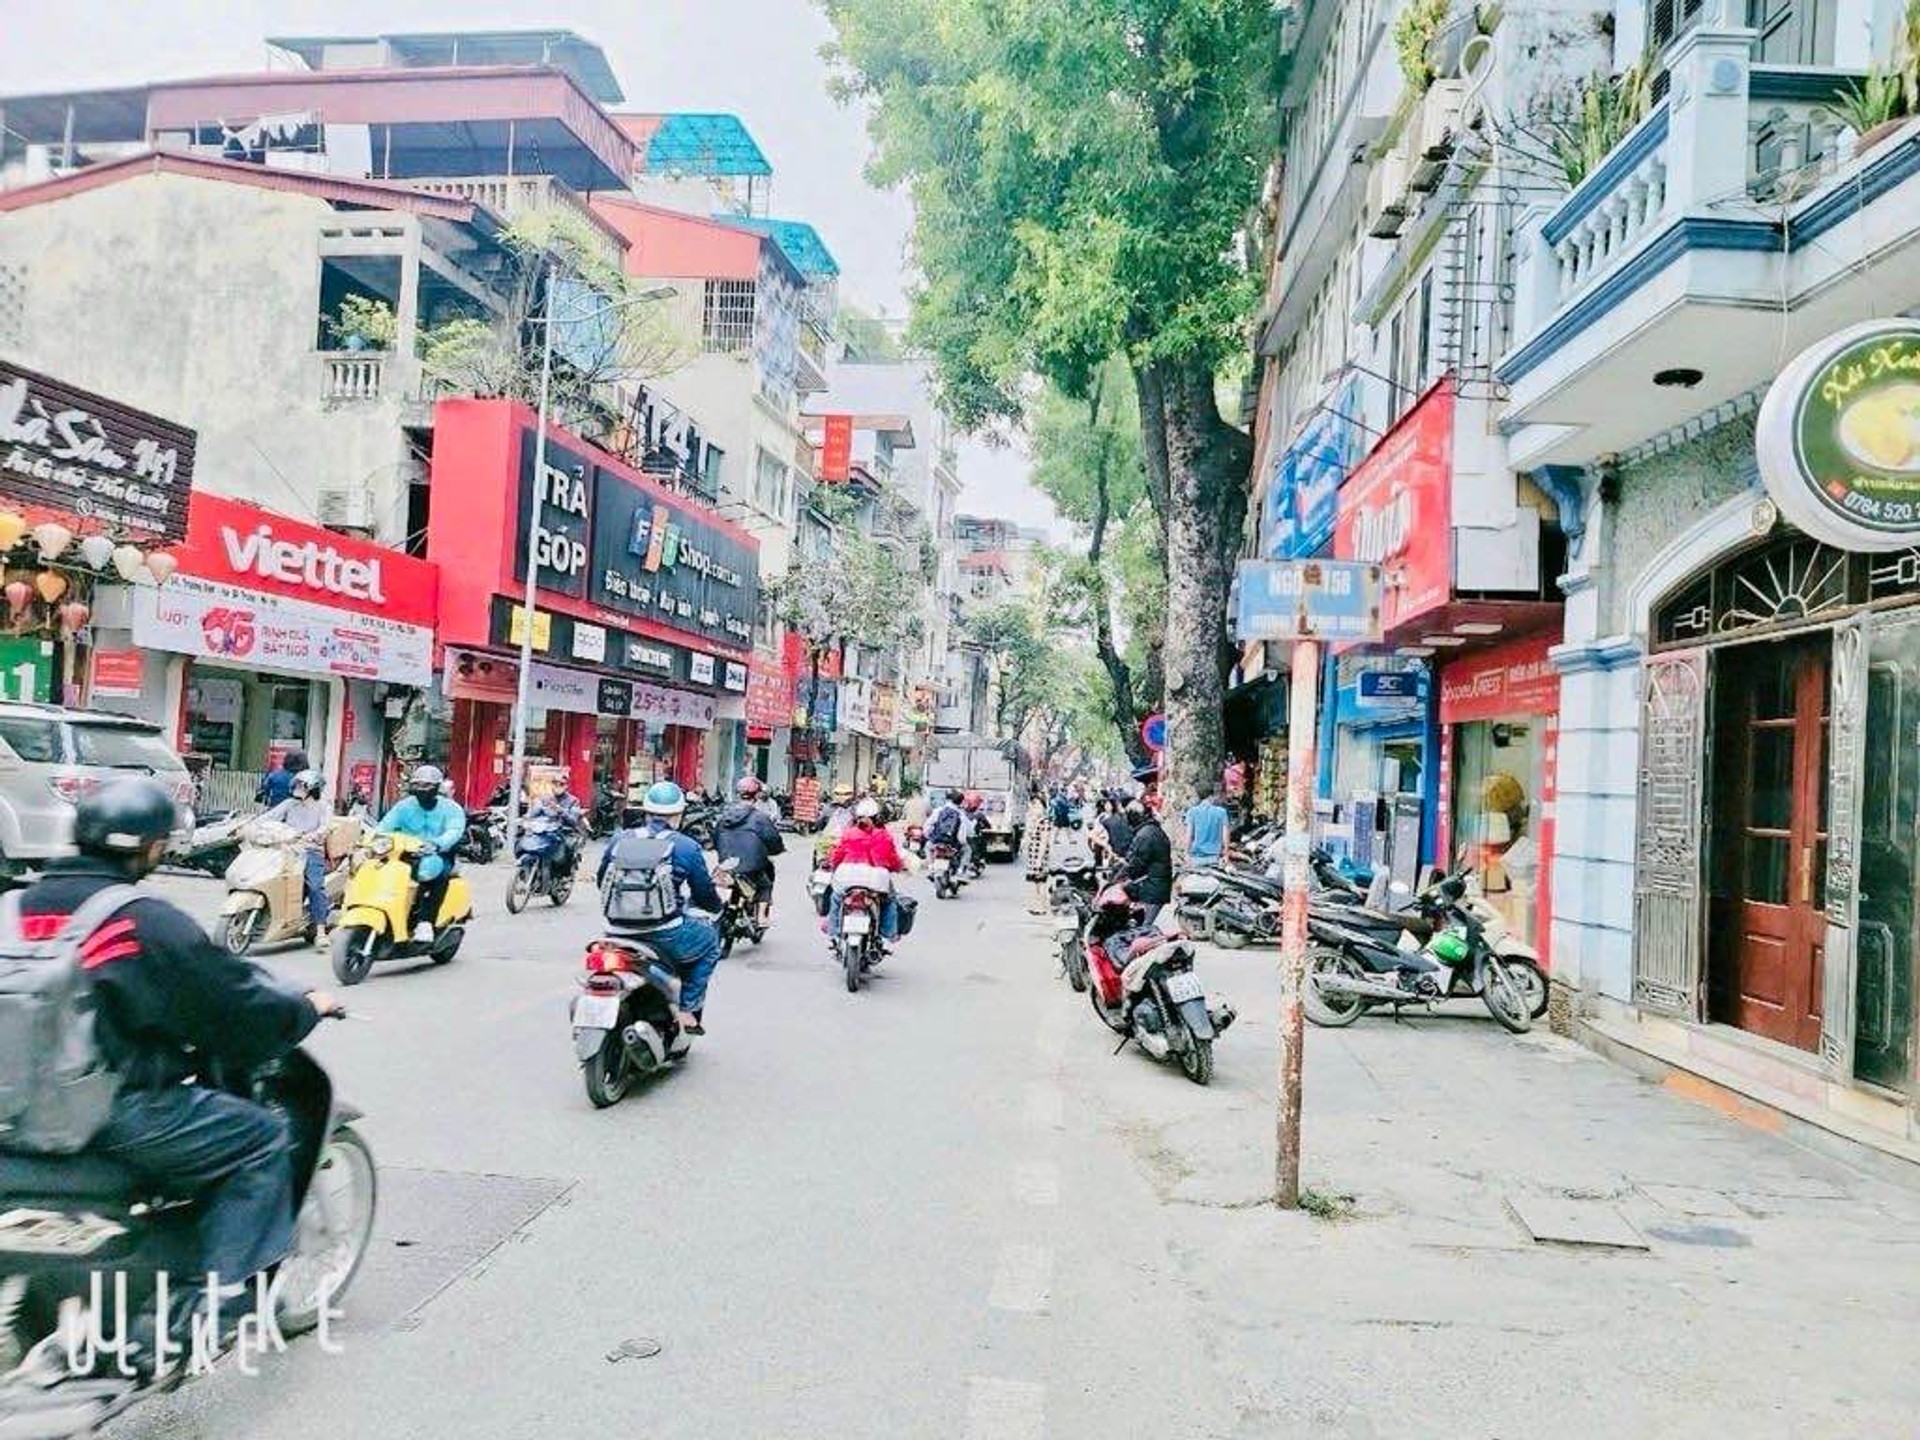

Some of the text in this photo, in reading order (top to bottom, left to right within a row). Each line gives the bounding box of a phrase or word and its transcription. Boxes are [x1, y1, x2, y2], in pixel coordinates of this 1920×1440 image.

[538, 464, 588, 518] TRẢ
[221, 525, 386, 604] viettel
[536, 525, 588, 576] GÓP
